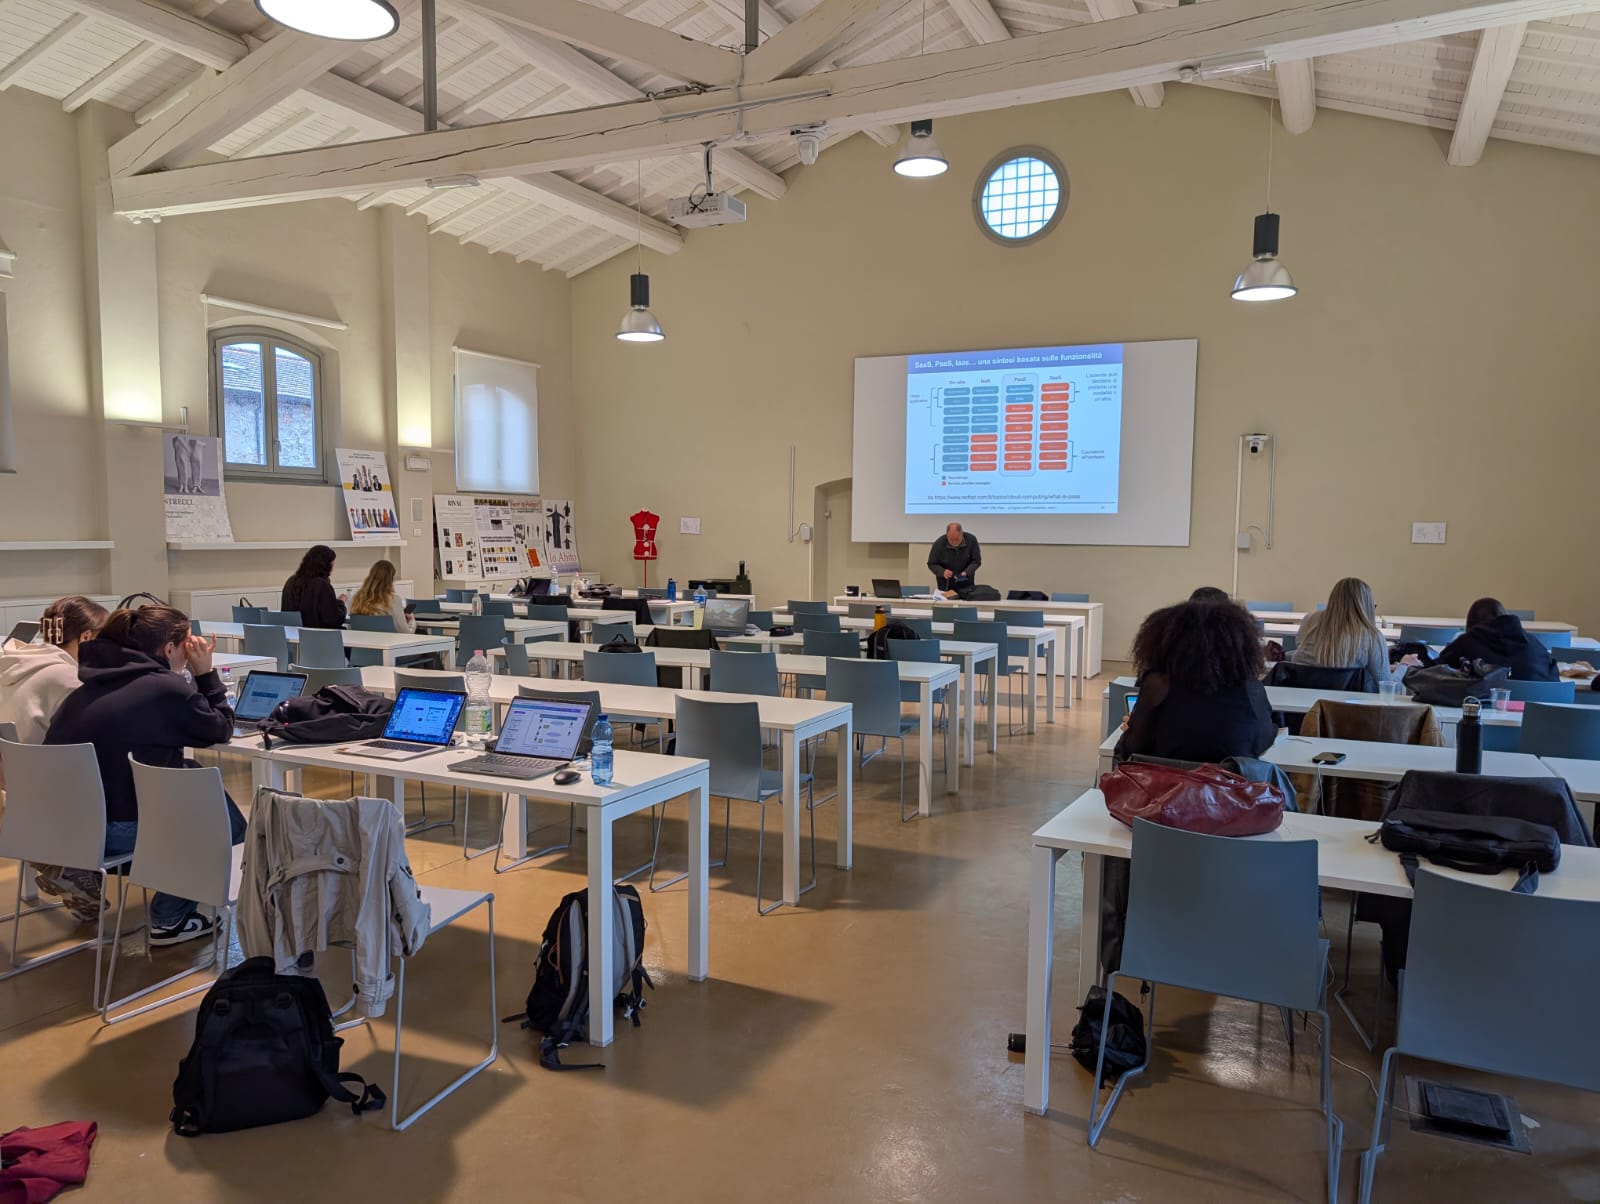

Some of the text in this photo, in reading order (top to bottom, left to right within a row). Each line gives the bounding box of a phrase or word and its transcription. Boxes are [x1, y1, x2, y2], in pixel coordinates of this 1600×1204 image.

[992, 356, 1015, 364] sintesi
[1016, 355, 1040, 363] basata
[1041, 354, 1059, 362] sulle
[1060, 352, 1103, 361] funzionalità
